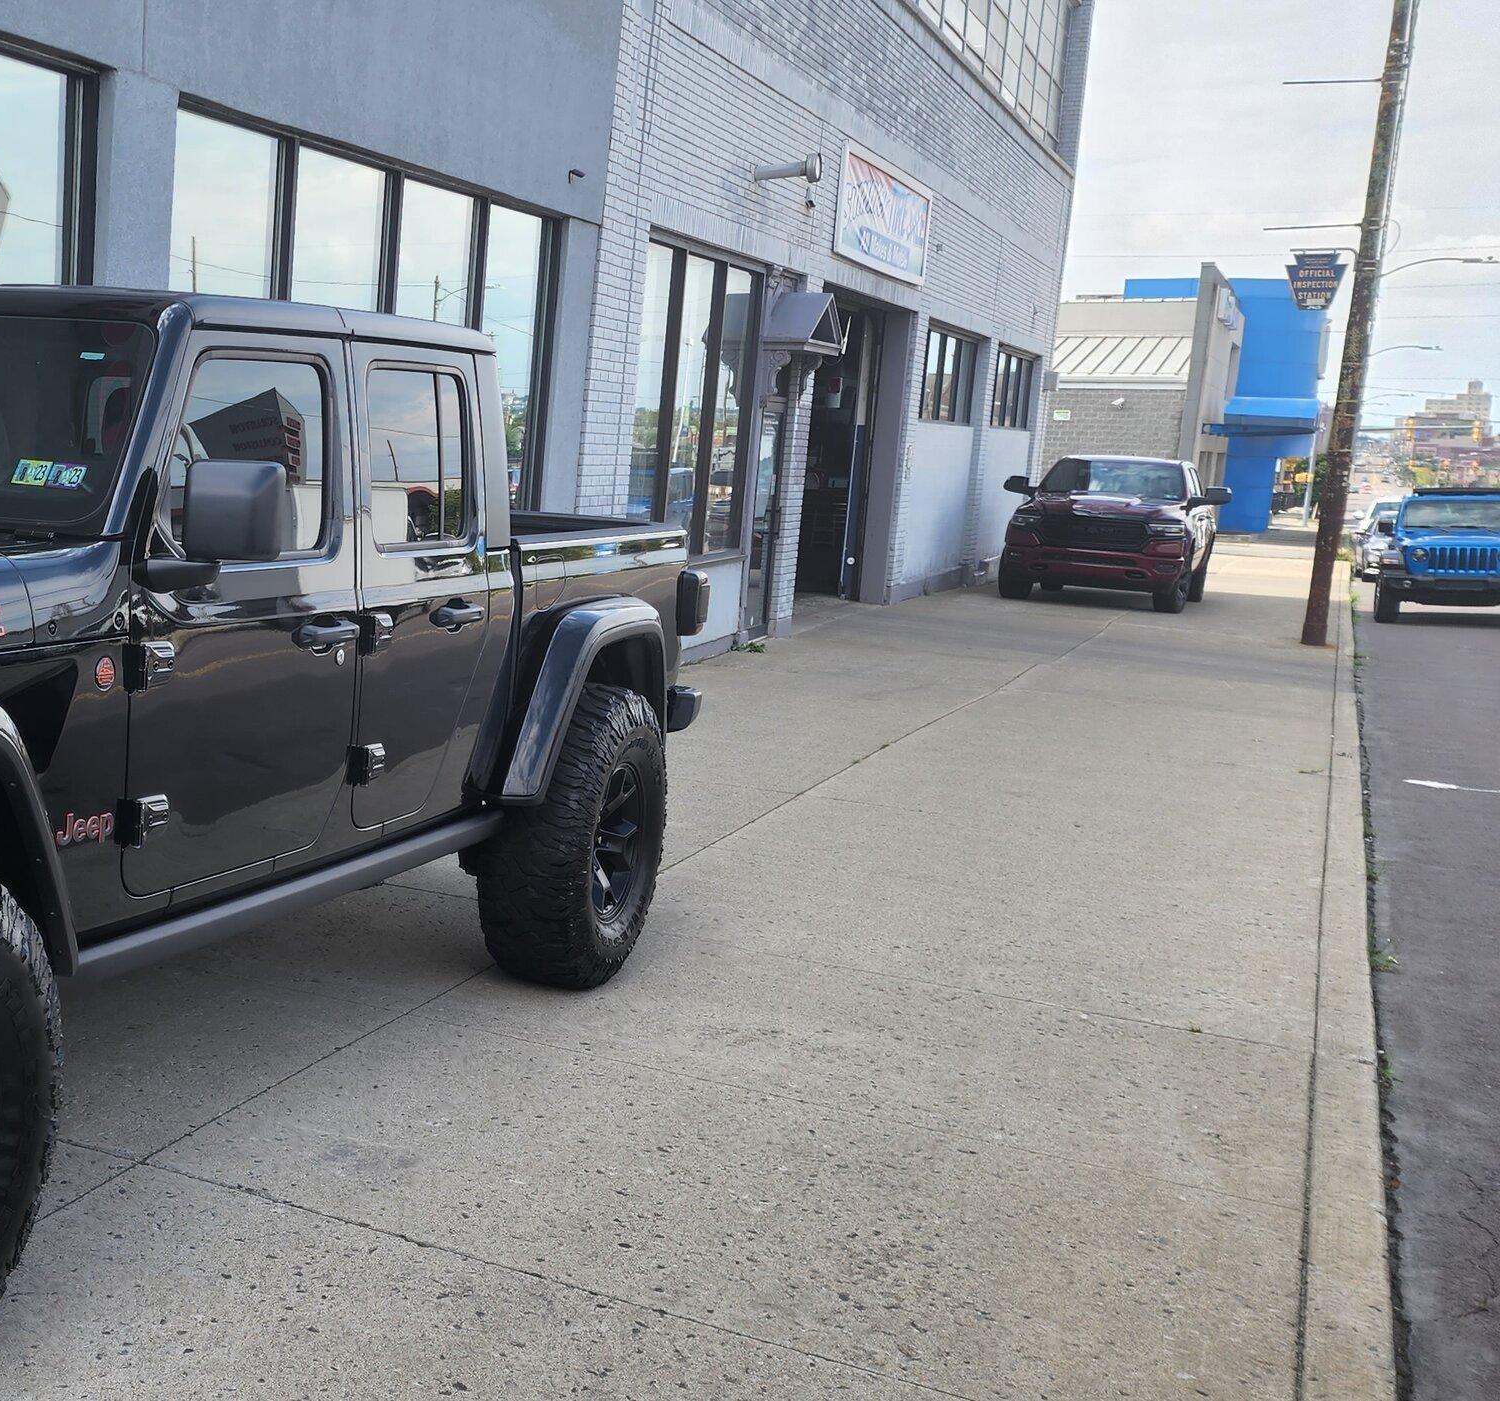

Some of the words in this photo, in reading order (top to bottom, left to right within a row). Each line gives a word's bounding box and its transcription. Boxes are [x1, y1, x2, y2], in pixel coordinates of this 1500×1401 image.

[1299, 269, 1336, 278] OFFICIAL
[1293, 280, 1338, 289] INSPECTION
[1297, 291, 1332, 300] STATION
[33, 464, 48, 481] 23
[68, 467, 83, 485] 23
[56, 811, 114, 847] Jeep
